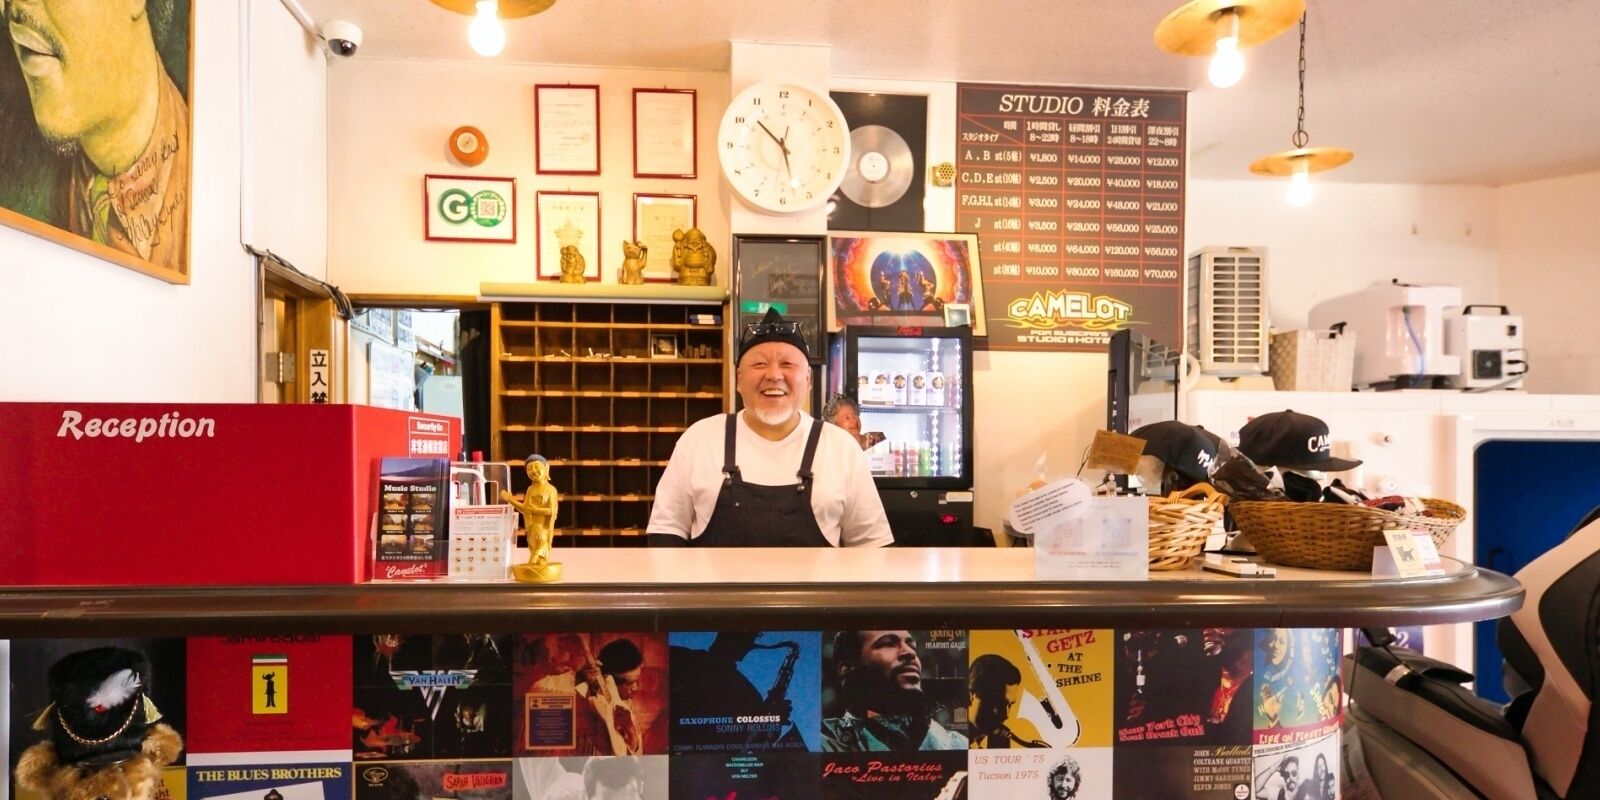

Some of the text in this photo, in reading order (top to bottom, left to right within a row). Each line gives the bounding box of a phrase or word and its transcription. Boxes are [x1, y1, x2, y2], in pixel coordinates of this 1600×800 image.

[808, 99, 812, 107] 1
[999, 94, 1150, 118] STUDIO 料金表
[826, 120, 833, 128] 2
[962, 133, 999, 142] スタジオタイプ
[825, 172, 831, 180] 4
[753, 189, 759, 197] 7
[806, 191, 813, 199] 5
[779, 197, 786, 205] 6
[975, 218, 981, 229] J
[1010, 292, 1131, 321] CAMELOT
[1017, 335, 1066, 343] STUDIO
[57, 410, 215, 443] Reception
[410, 484, 437, 492] Studio
[1047, 630, 1095, 653] GETZ
[1068, 652, 1083, 661] AT
[1057, 664, 1082, 673] THE
[408, 675, 460, 684] VAN HALEN
[1056, 672, 1101, 687] SHRINE
[680, 715, 781, 725] SAXOPHONE COLOSSUS
[716, 723, 781, 733] SONNY ROLLINS
[1259, 733, 1280, 744] LIFE
[1282, 732, 1293, 742] ON
[1215, 745, 1251, 756] Ballads
[974, 756, 988, 764] US
[994, 755, 1022, 764] TOUR
[822, 761, 943, 778] Jaco Pastorius
[196, 767, 342, 782] THE BLUES BROTHERS
[888, 774, 900, 782] in
[978, 771, 1040, 780] Tucson 1975
[1193, 783, 1212, 791] ELVIN
